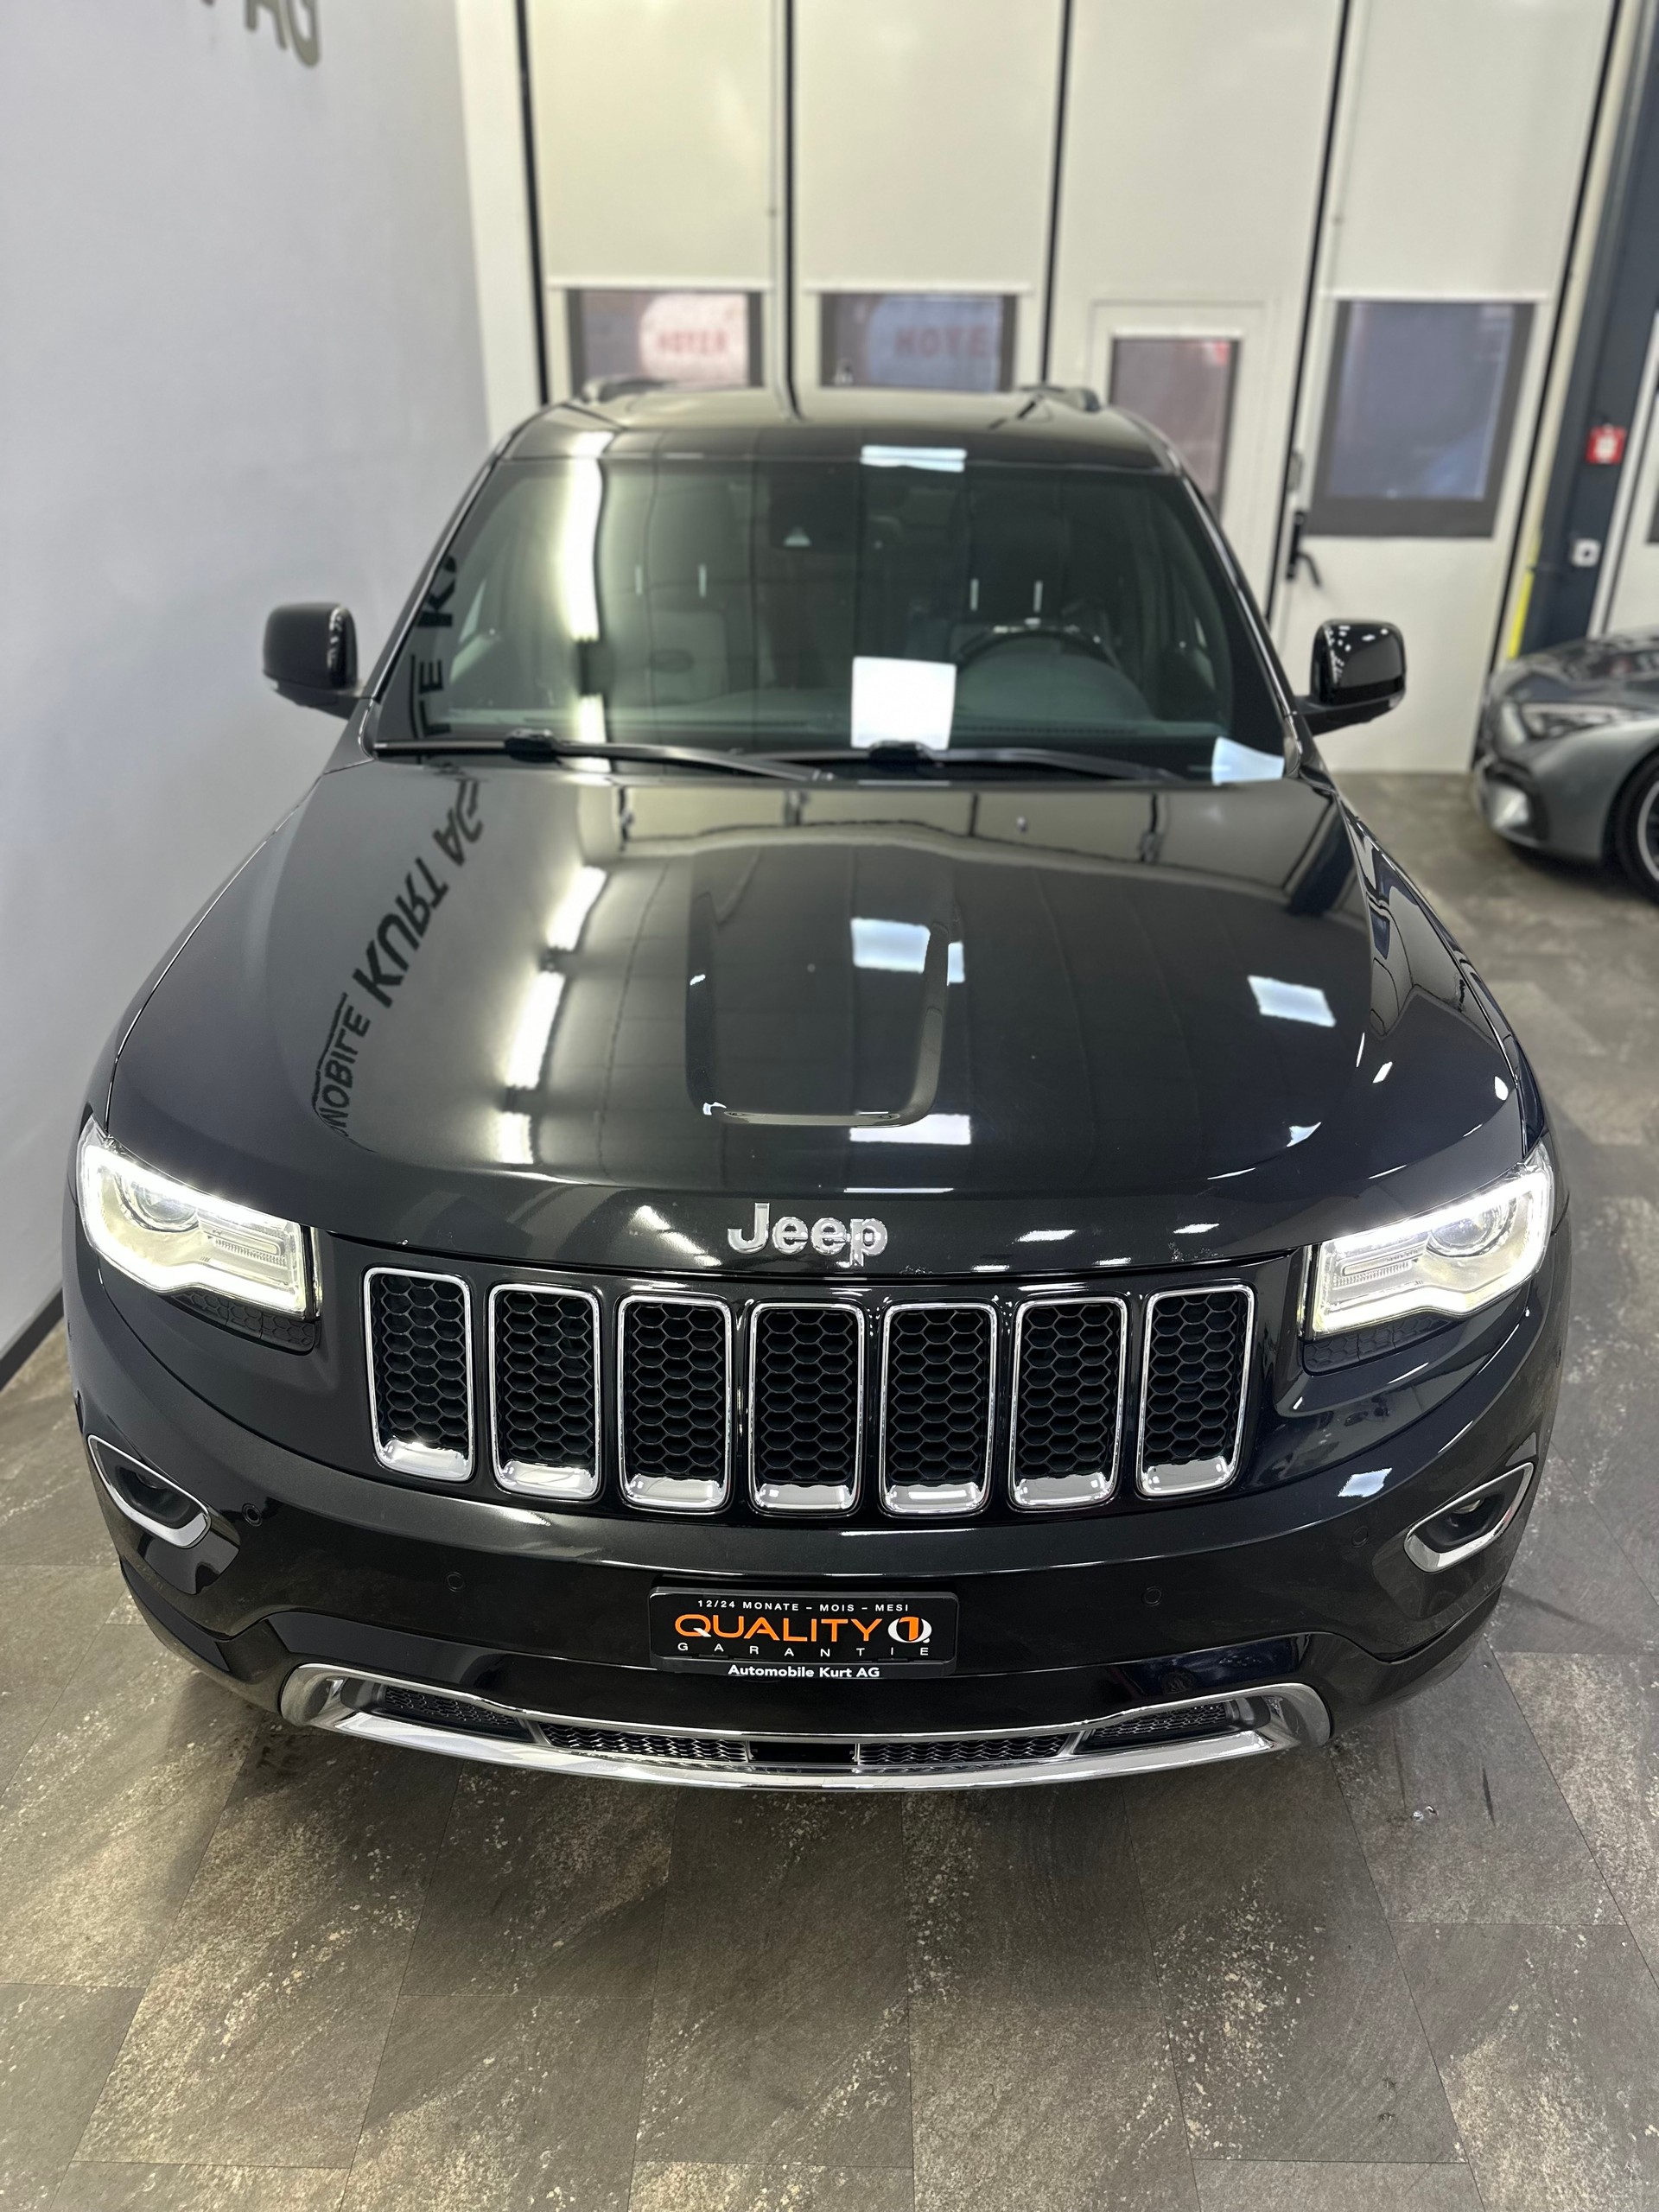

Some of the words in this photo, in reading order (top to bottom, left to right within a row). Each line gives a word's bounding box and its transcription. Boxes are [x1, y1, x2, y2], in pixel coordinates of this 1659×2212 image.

[728, 1202, 888, 1268] Jeep
[698, 1599, 735, 1608] 12/24
[742, 1601, 799, 1611] MONATE
[677, 1643, 929, 1656] GARANTIE
[728, 1664, 815, 1678] Automobile
[819, 1666, 852, 1678] Kurt
[855, 1667, 880, 1678] AG
